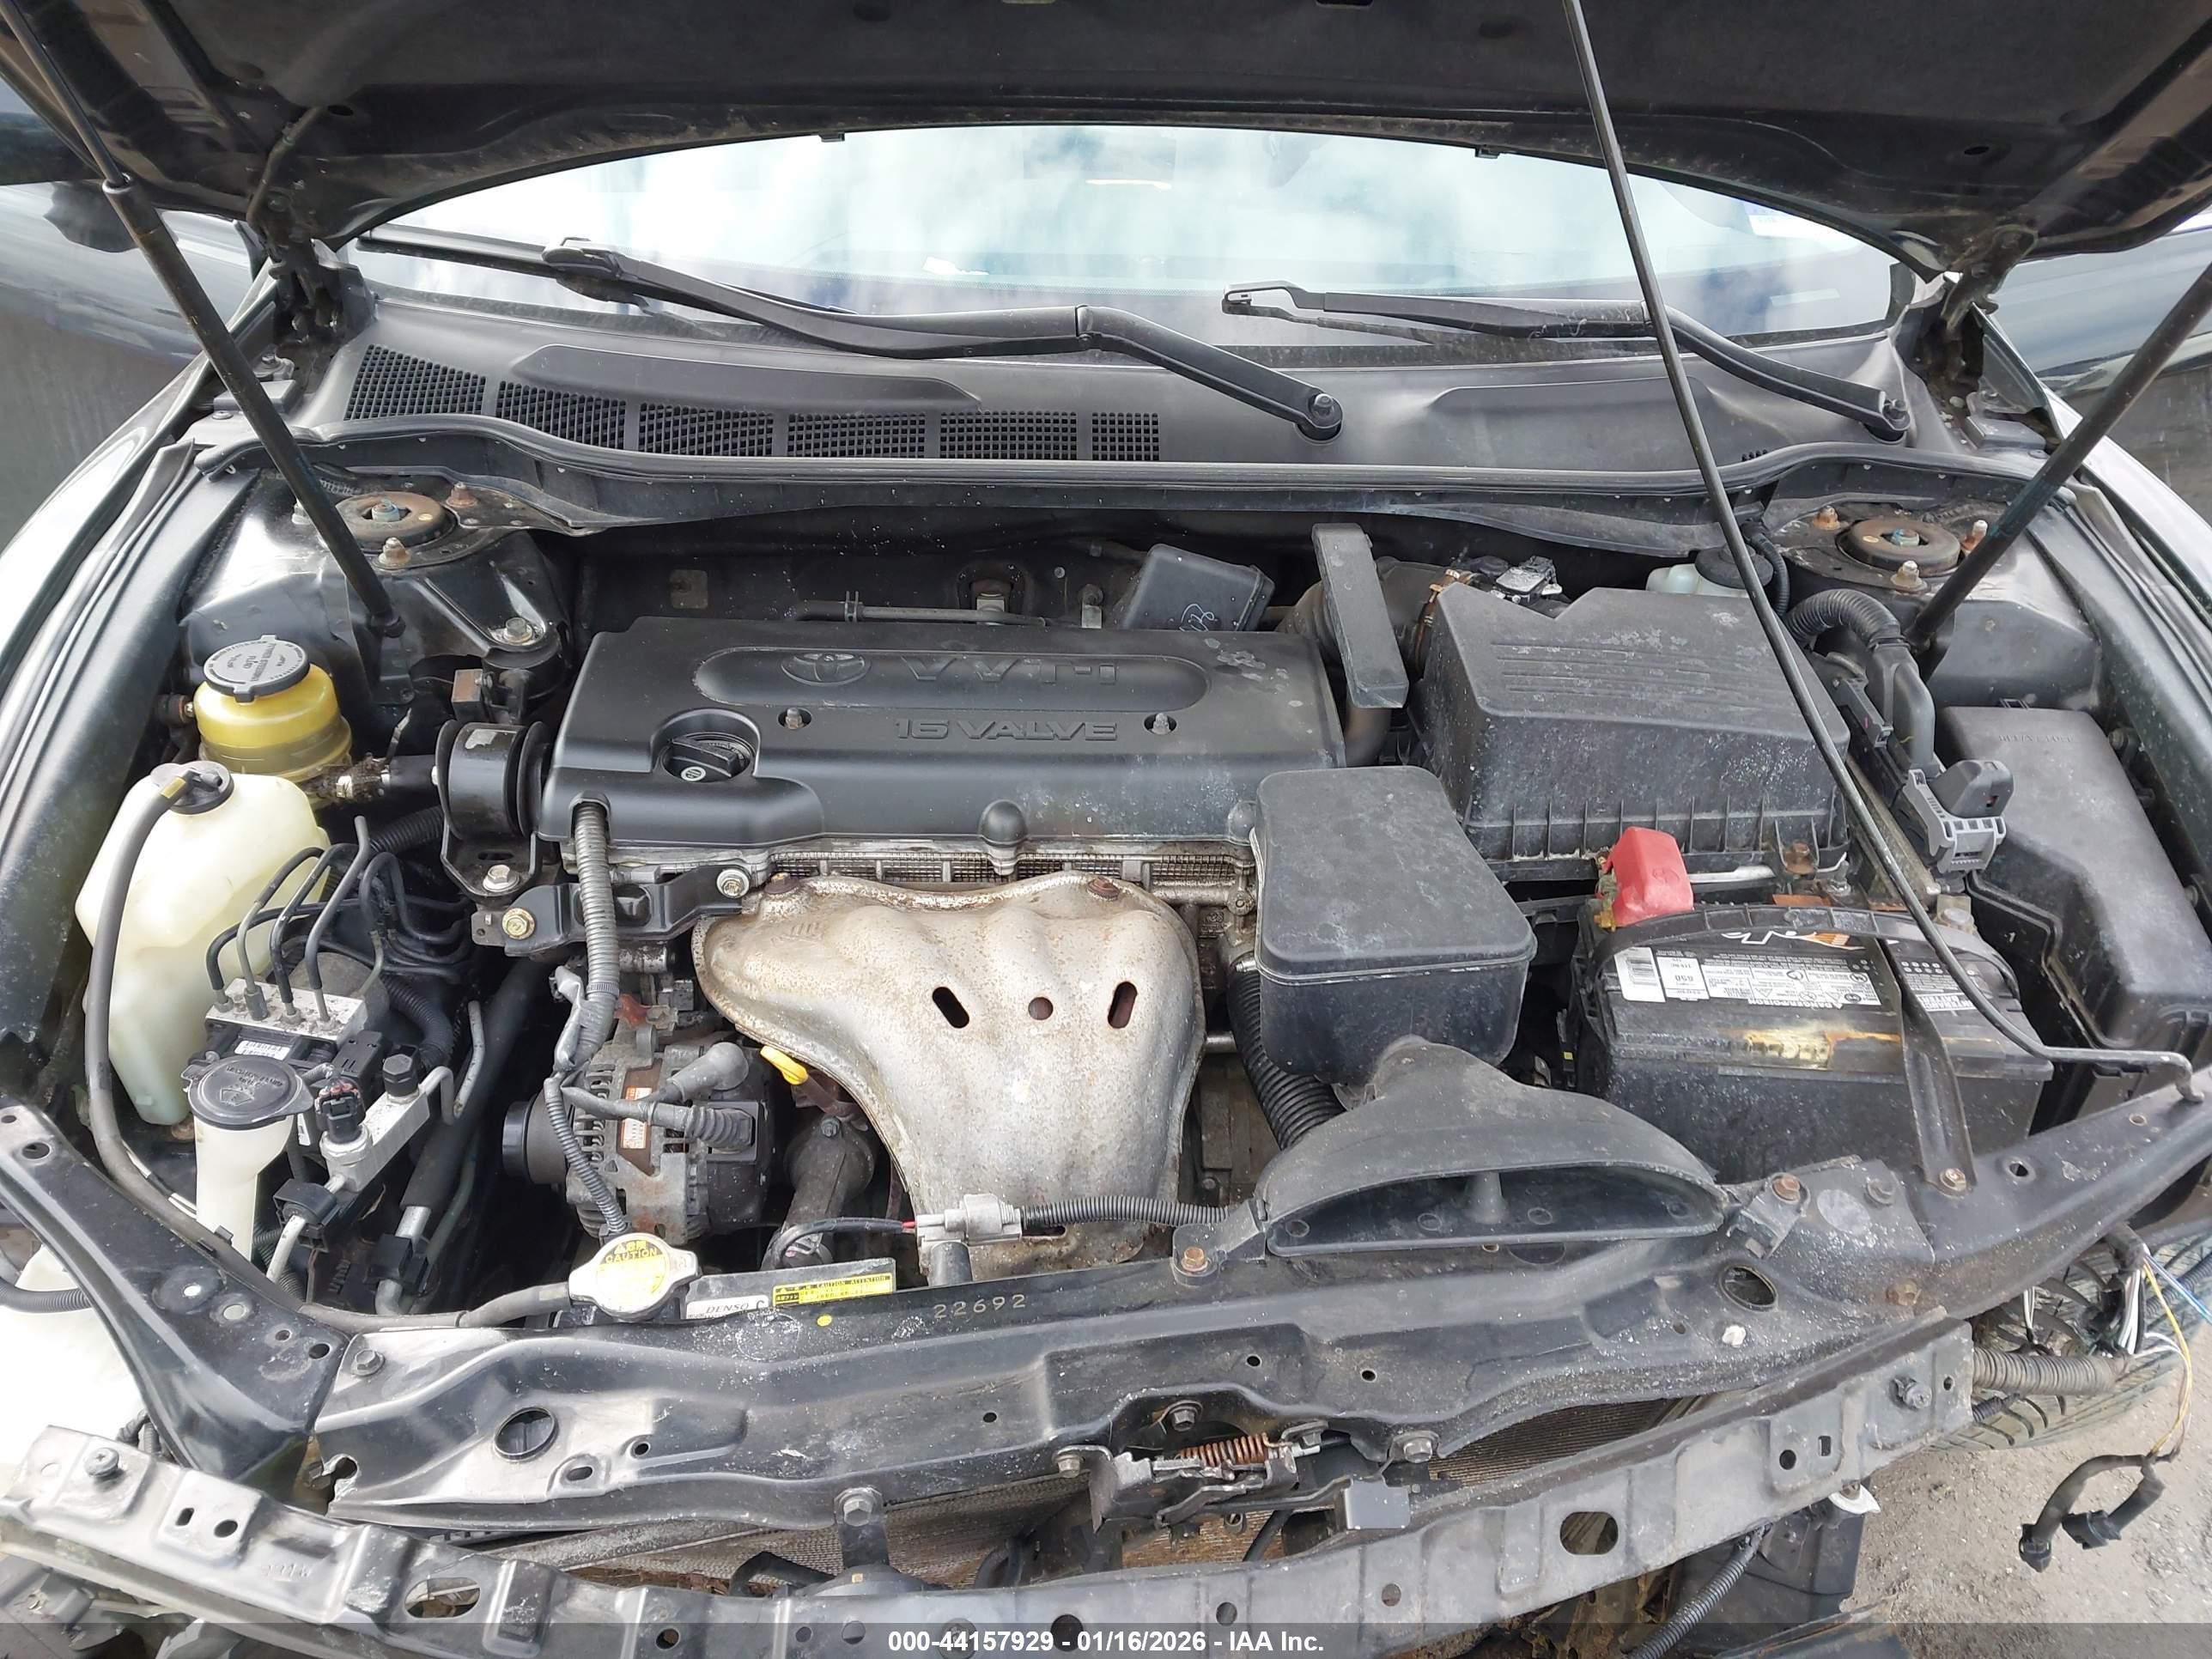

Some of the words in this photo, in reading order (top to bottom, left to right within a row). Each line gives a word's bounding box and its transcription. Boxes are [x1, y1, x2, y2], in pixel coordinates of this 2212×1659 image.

[896, 719, 950, 739] 16
[957, 720, 1119, 741] VALVE
[605, 1247, 658, 1265] CAUTION
[705, 1302, 750, 1314] DENSO
[933, 1294, 1026, 1319] 22692
